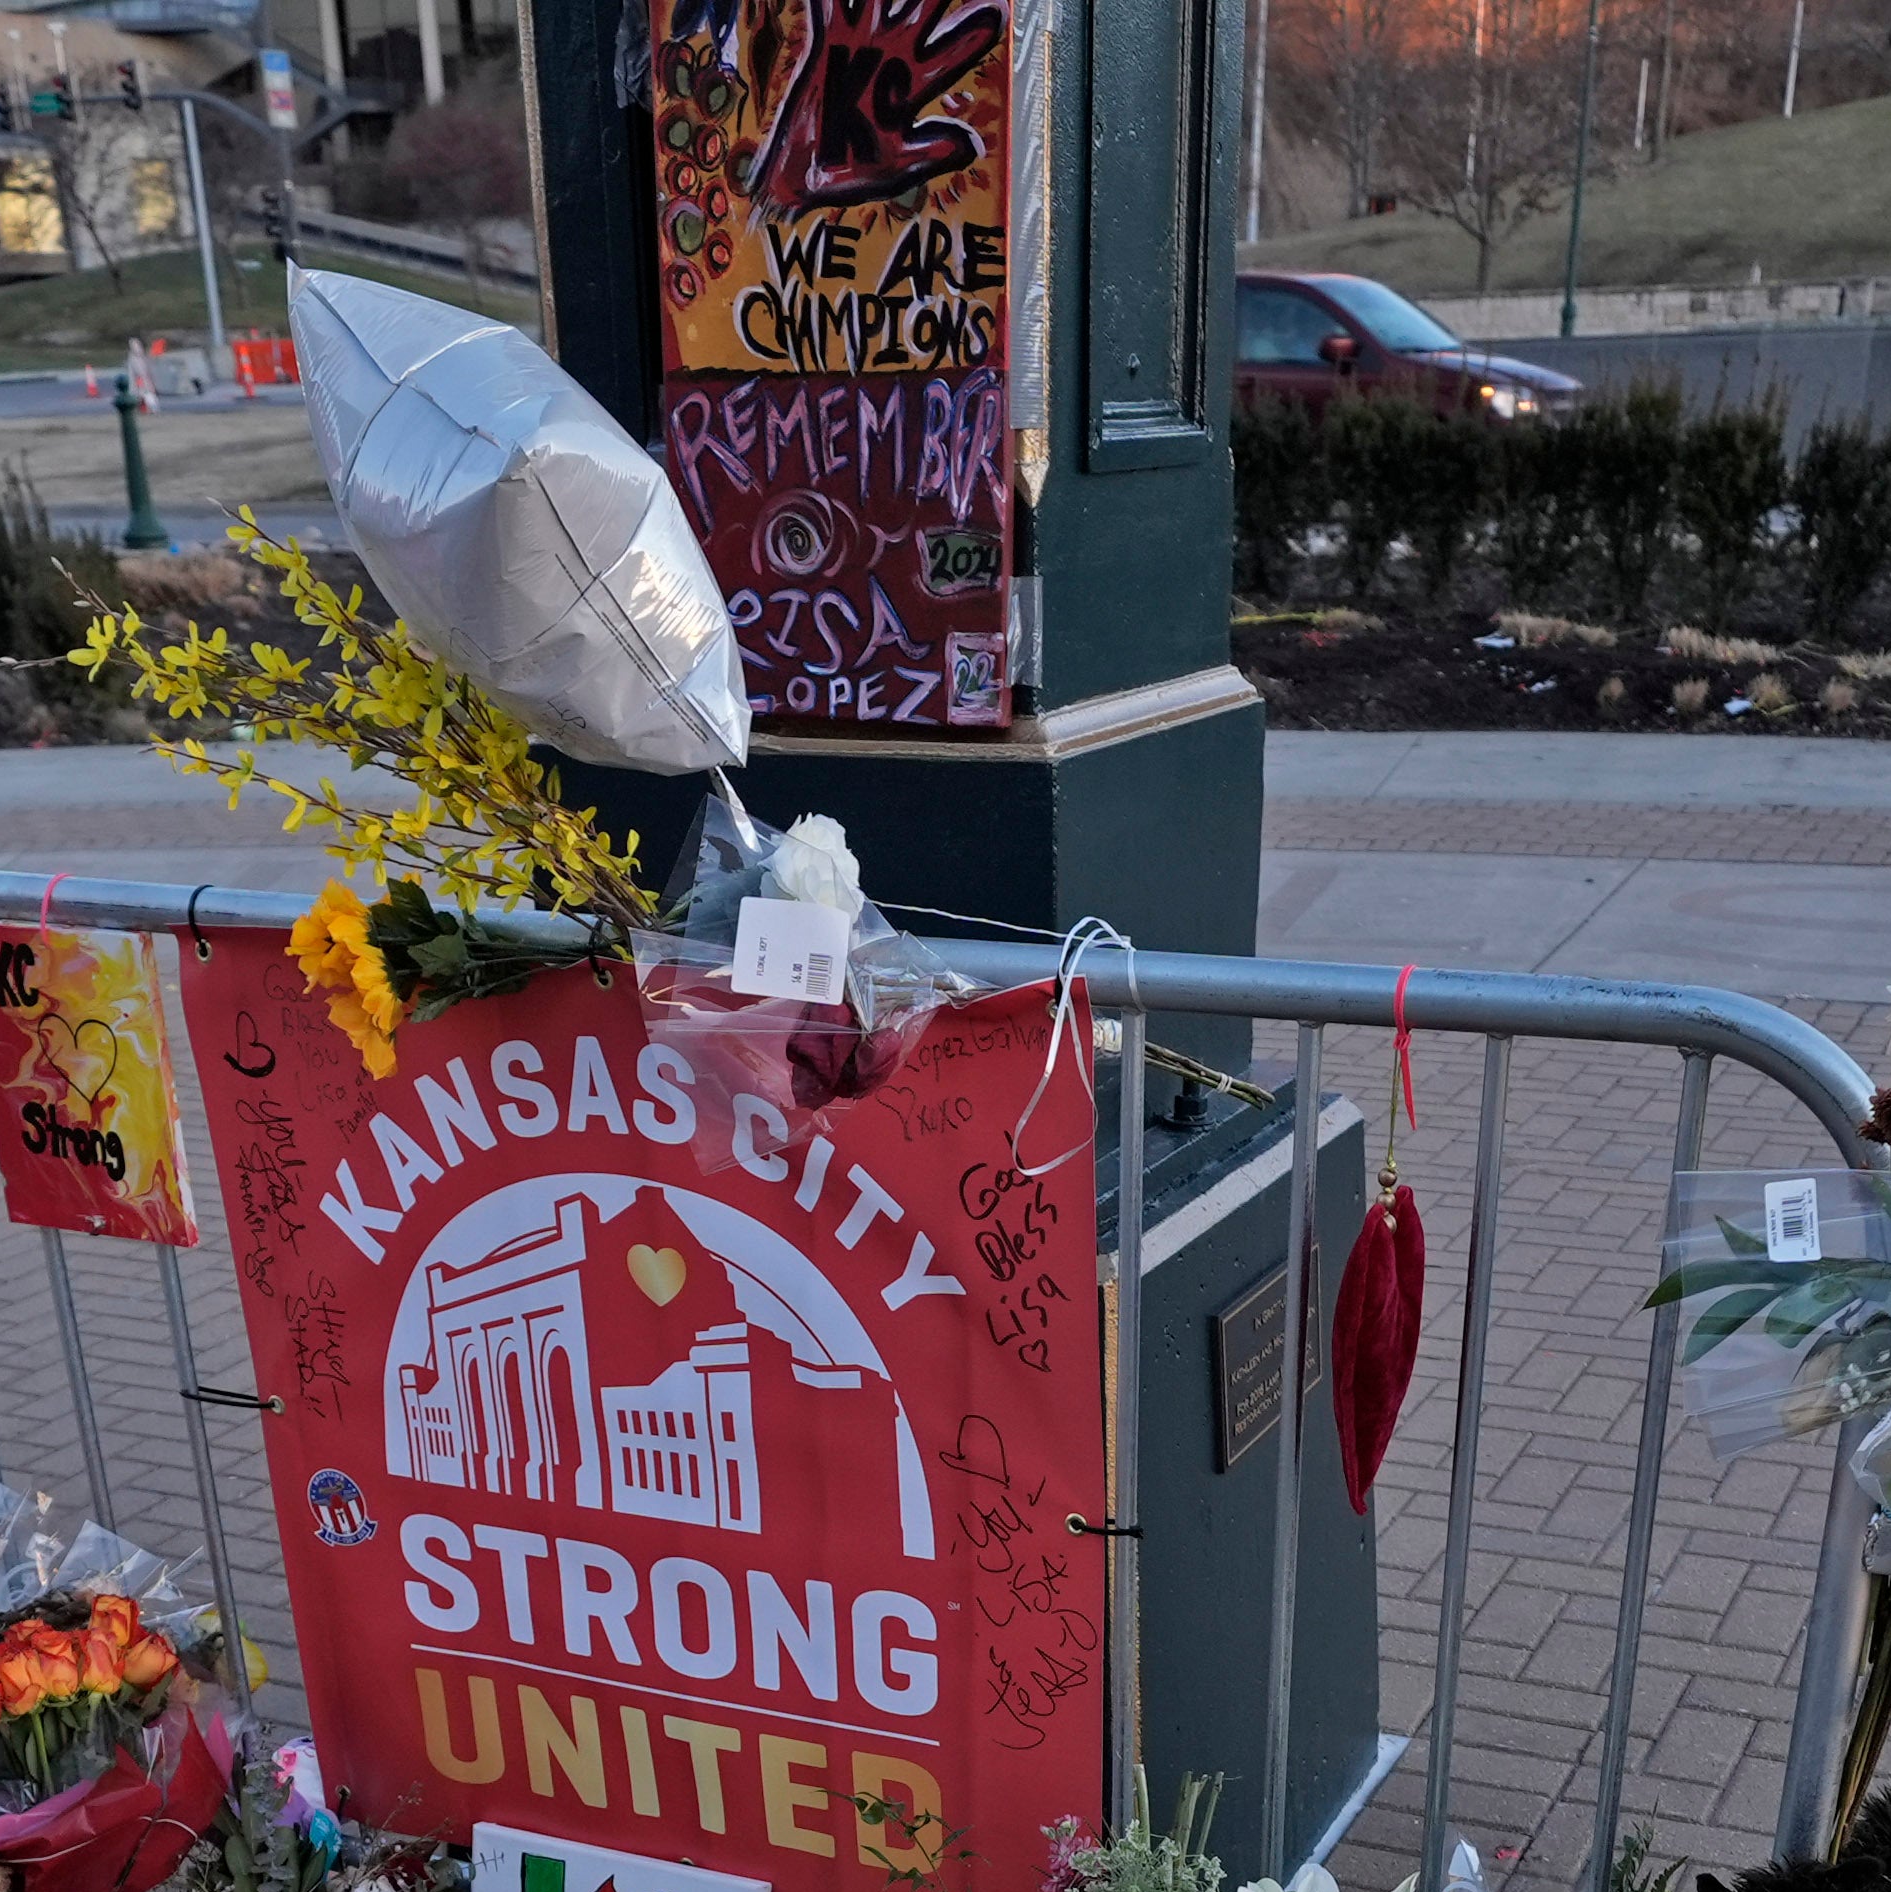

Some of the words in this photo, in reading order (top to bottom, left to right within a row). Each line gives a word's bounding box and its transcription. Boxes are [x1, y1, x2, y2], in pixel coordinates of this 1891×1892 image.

[765, 224, 861, 283] WE
[877, 225, 1005, 295] ARE
[734, 283, 994, 376] CHAMPIONS
[670, 377, 1007, 540] REMEMBER
[930, 537, 1001, 584] 2024
[21, 1101, 126, 1181] Strong
[318, 1035, 698, 1266] KANSAS
[732, 1092, 966, 1312] CITY
[975, 1182, 1057, 1283] Bless
[402, 1513, 939, 1718] STRONG
[413, 1666, 943, 1875] UNITED
